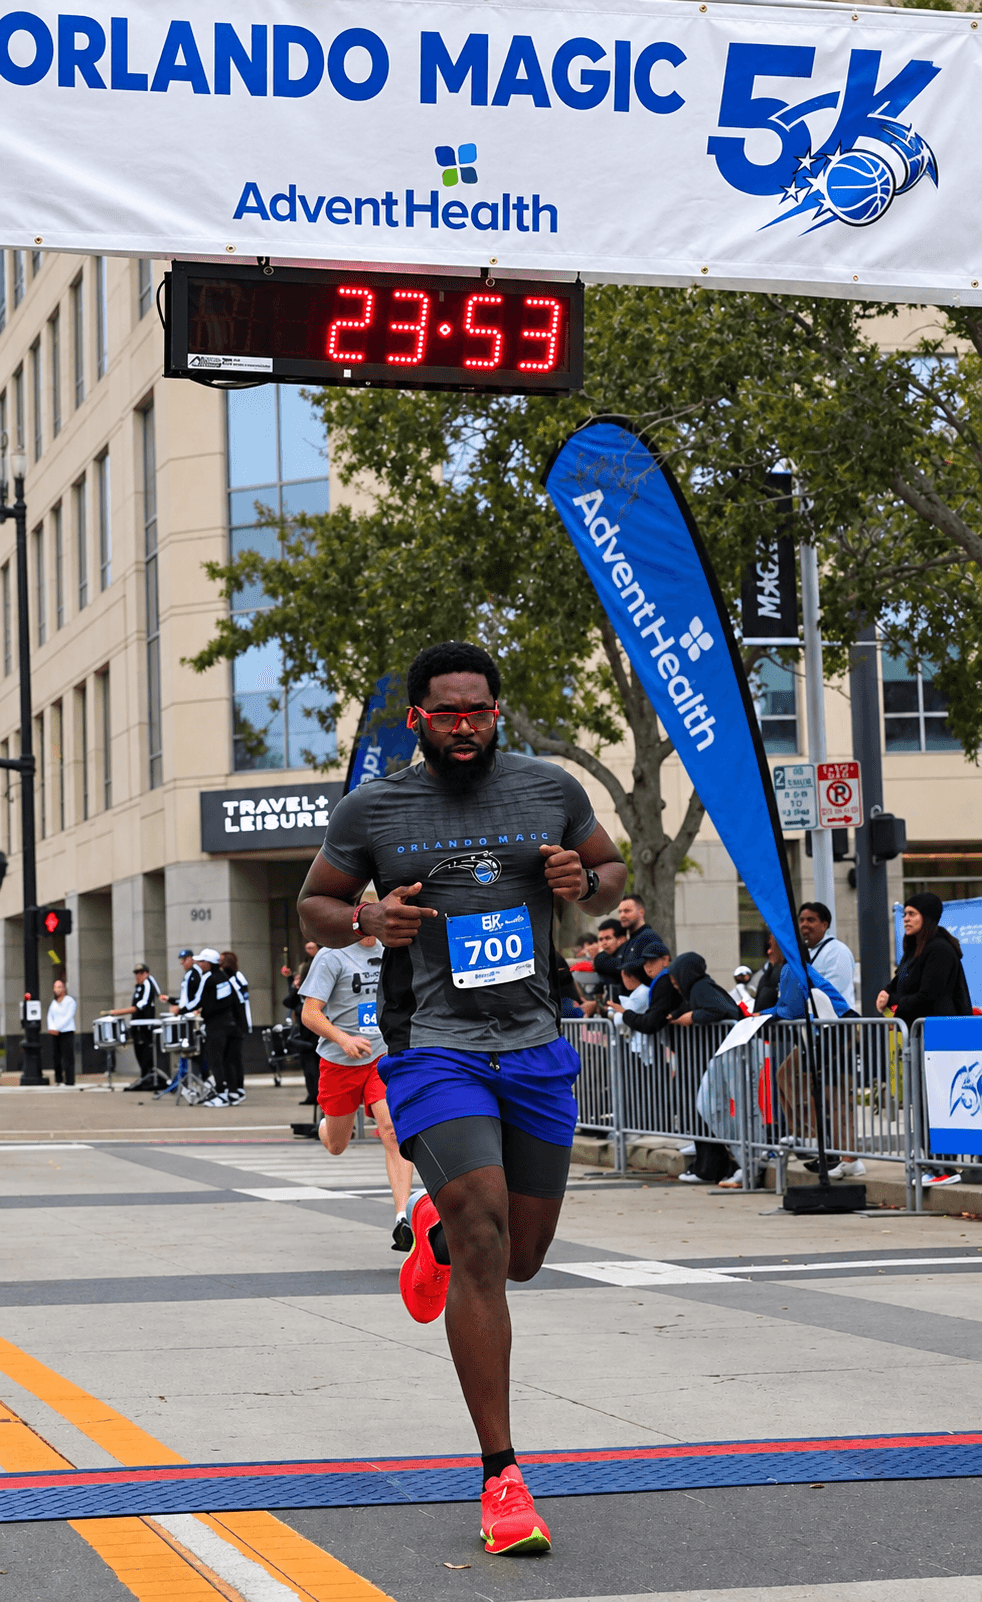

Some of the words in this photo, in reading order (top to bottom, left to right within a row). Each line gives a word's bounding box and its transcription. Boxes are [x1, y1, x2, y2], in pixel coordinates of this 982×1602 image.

[0, 11, 390, 102] ORLANDO
[419, 31, 688, 115] MAGIC
[707, 42, 942, 200] 5K
[232, 181, 558, 235] AdventHealth
[327, 285, 562, 372] 23:53
[572, 488, 717, 753] AdventHealth
[775, 770, 785, 787] 2
[224, 810, 329, 833] LEISURE
[396, 837, 488, 854] ORLANDO
[190, 908, 212, 921] 901
[464, 934, 522, 965] 700
